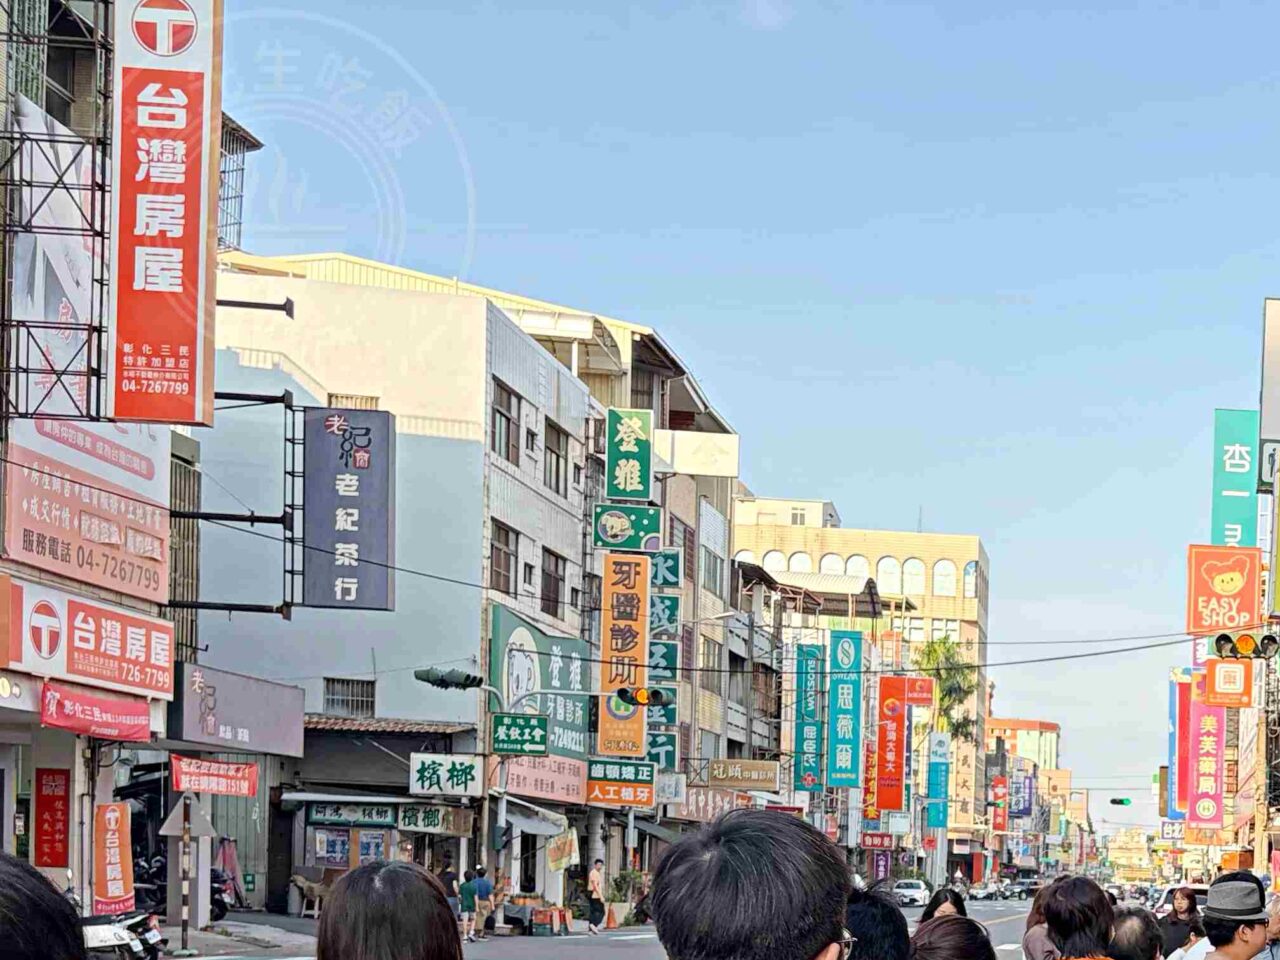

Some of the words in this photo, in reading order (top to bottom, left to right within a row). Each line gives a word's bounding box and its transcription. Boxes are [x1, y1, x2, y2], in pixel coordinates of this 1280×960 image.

[133, 82, 188, 293] 台灣房屋
[123, 343, 190, 357] 彰化三民
[123, 356, 190, 368] 特許加盟店
[122, 379, 190, 395] 04-7267799
[613, 416, 647, 492] 登雅
[1222, 443, 1252, 497] 杏一
[335, 473, 360, 601] 老紀茶行
[22, 528, 72, 564] 服務電話
[76, 545, 160, 592] 04-7267799
[1198, 597, 1241, 612] EASY
[1202, 611, 1250, 627] SHOP
[608, 560, 641, 686] 牙醫診所
[73, 611, 170, 668] 台灣房屋
[121, 662, 170, 689] 726-7799
[494, 725, 546, 742] 餐飲工會
[836, 683, 853, 769] 思薇爾
[1198, 714, 1218, 795] 美芙藥局
[416, 760, 476, 792] 檳榔
[591, 763, 652, 779] 齒顎矯正
[590, 784, 650, 800] 人工植牙
[401, 806, 440, 828] 檳榔
